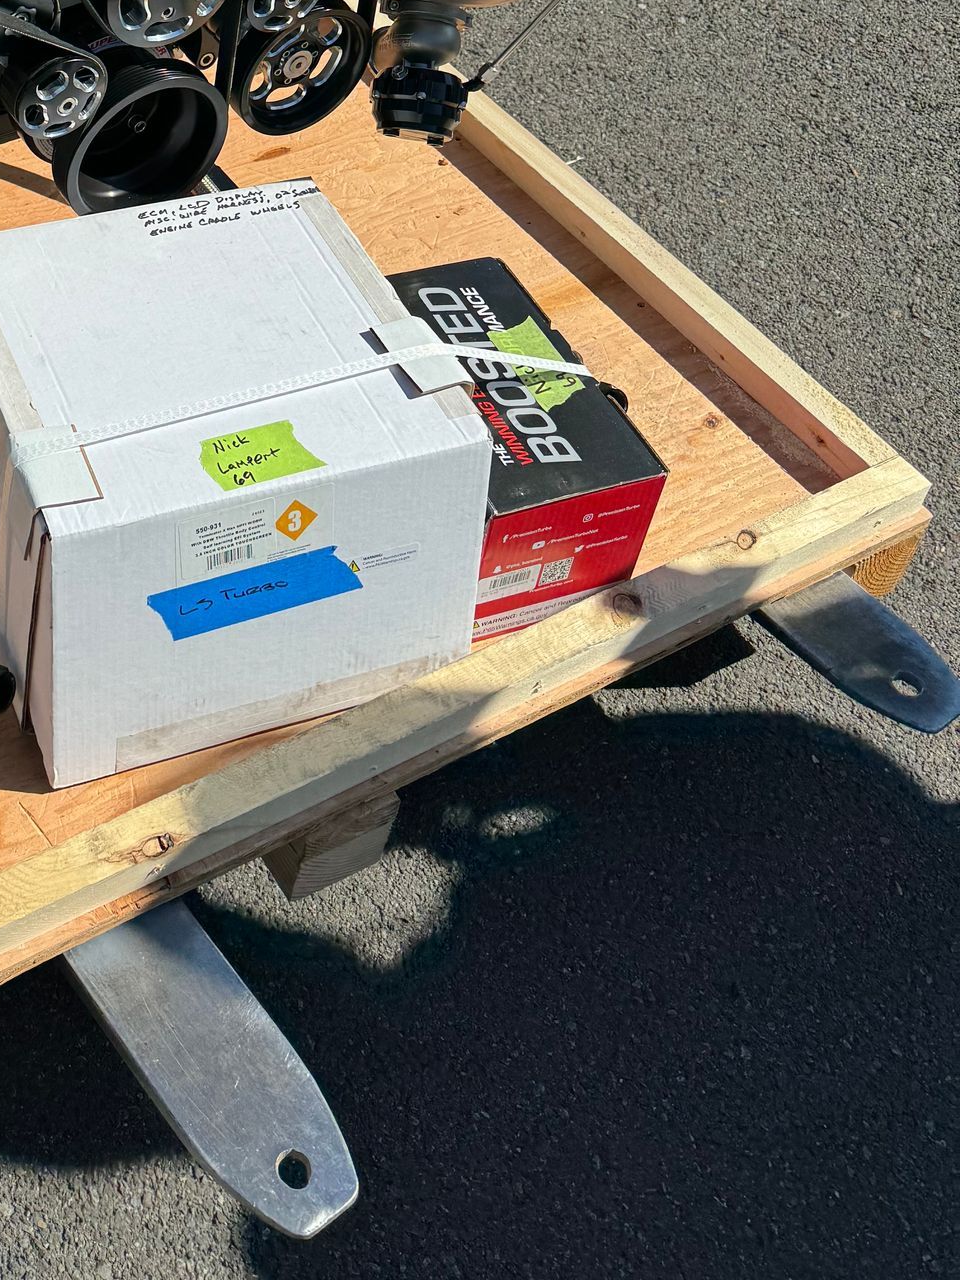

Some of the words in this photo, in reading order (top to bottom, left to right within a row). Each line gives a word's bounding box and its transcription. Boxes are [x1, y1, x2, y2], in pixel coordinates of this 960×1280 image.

[179, 200, 211, 210] LCD
[149, 221, 193, 237] ENGINE
[250, 200, 301, 216] WHEELS
[417, 286, 583, 464] BOOSTED
[212, 433, 251, 455] Nick
[477, 400, 535, 467] WINNING
[216, 447, 281, 475] Lampert
[491, 443, 515, 467] THE
[232, 470, 257, 486] 69
[195, 521, 222, 535] 550-931
[287, 509, 303, 533] 3
[179, 597, 214, 616] LS
[481, 612, 518, 628] WARNING:
[519, 606, 543, 618] Cancer
